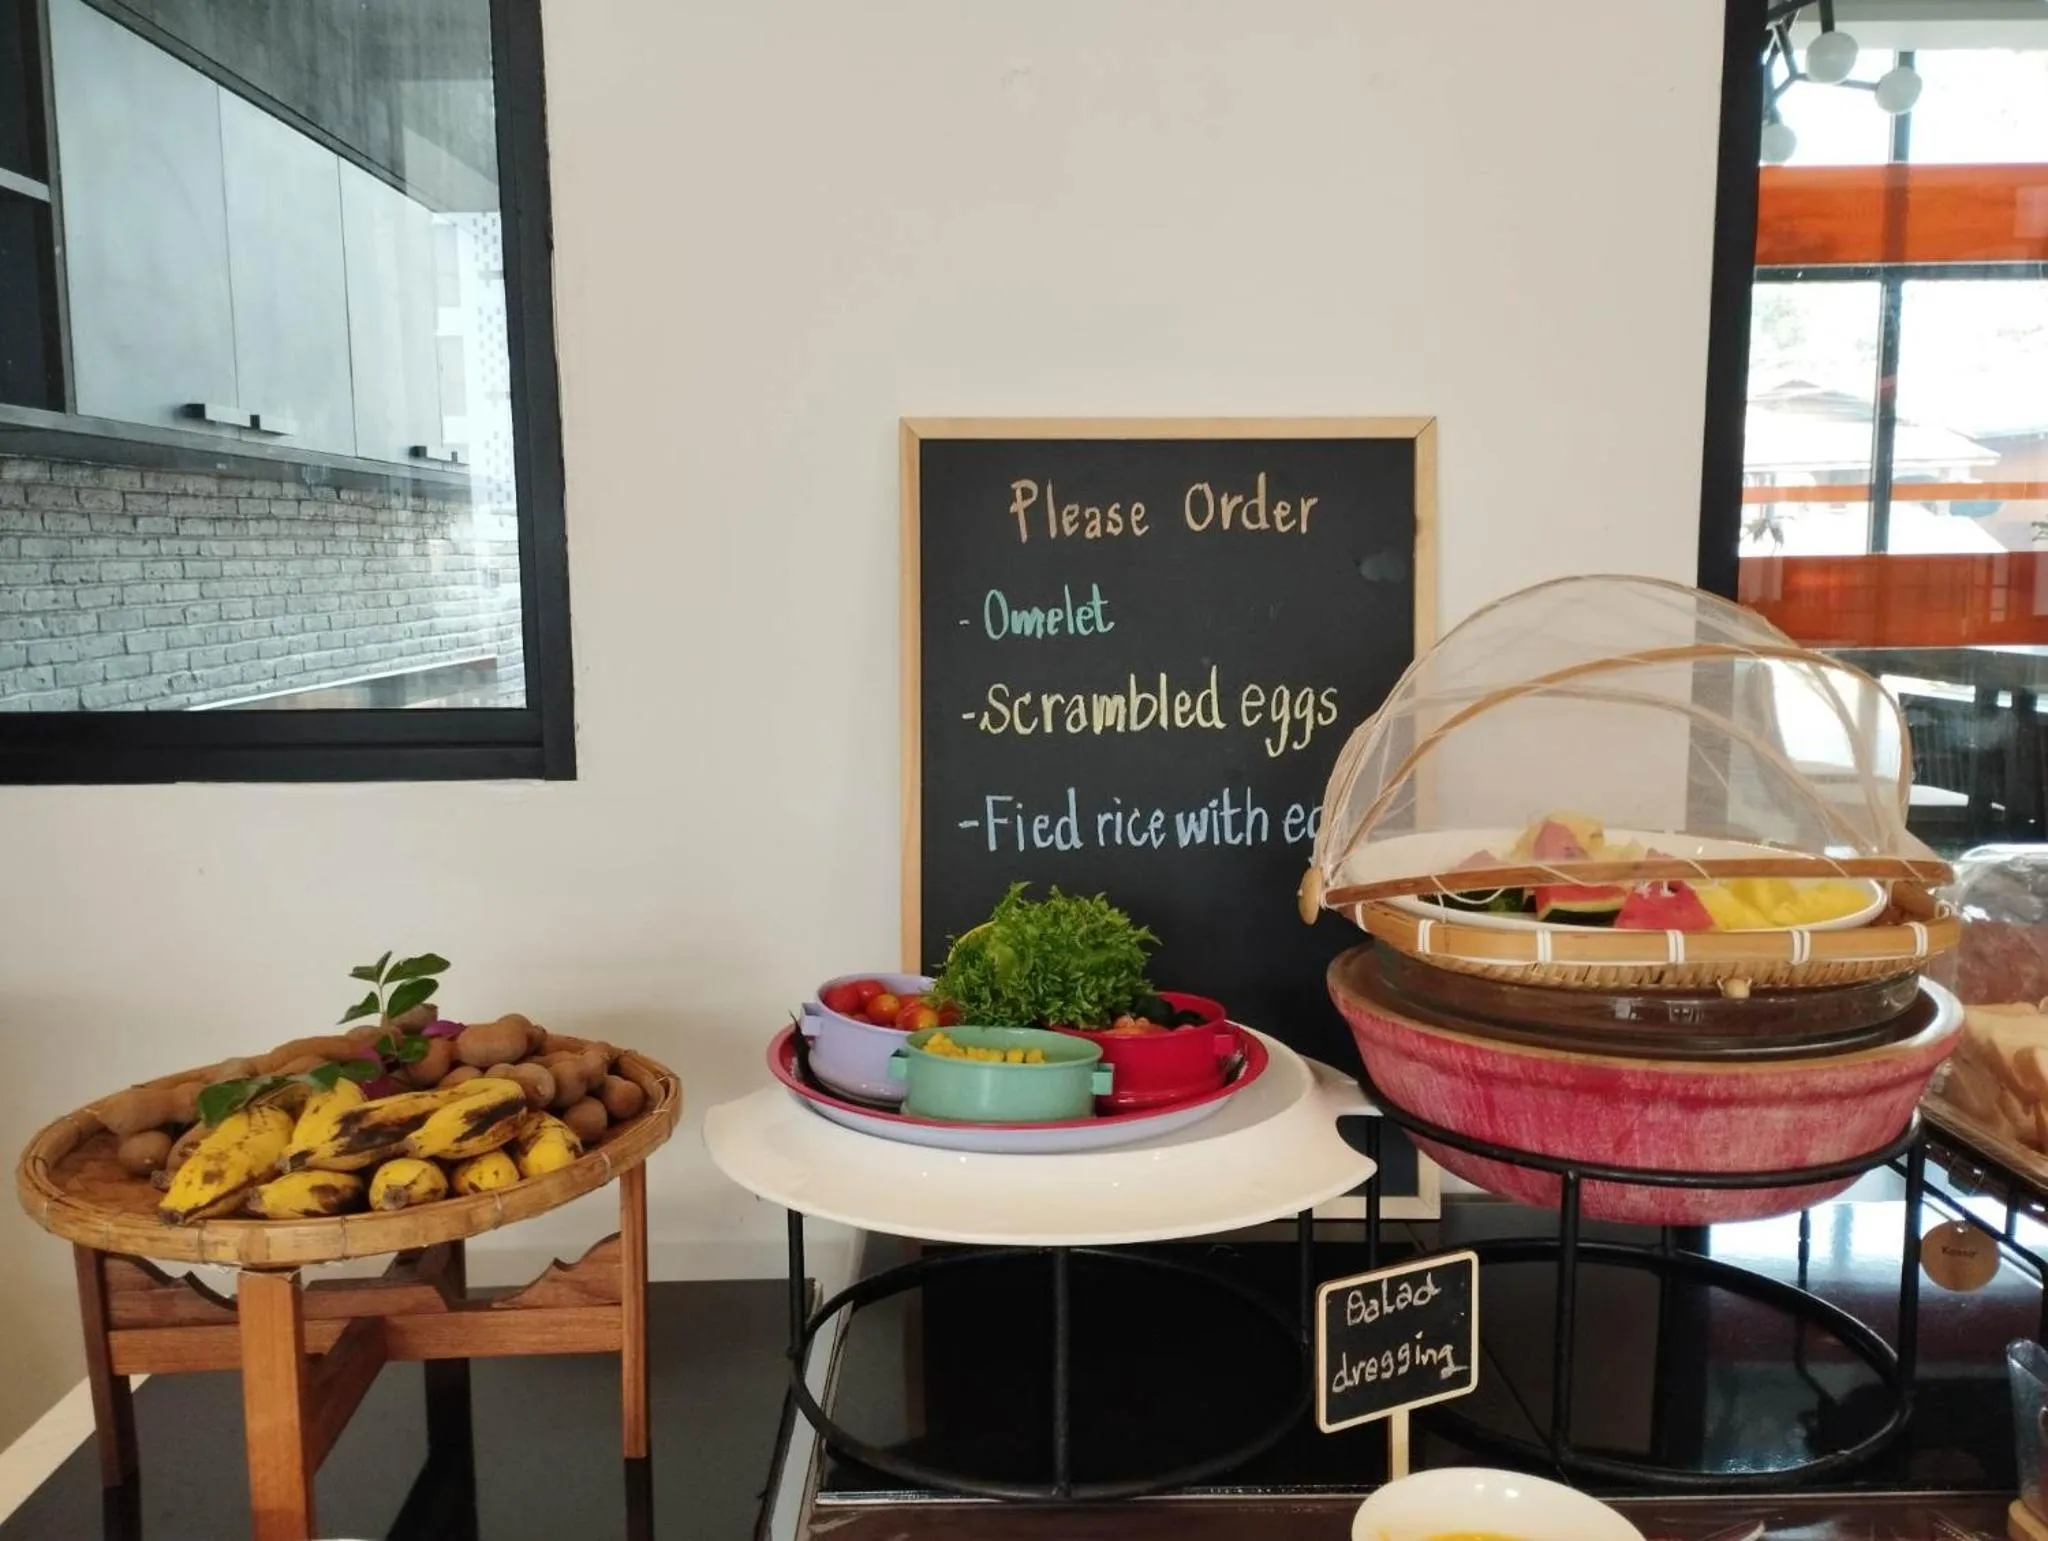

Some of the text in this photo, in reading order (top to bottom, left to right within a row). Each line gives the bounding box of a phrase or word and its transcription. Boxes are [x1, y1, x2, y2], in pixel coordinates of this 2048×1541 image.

[1009, 471, 1319, 544] Please Order
[983, 582, 1115, 641] Omelet
[1240, 683, 1339, 758] eggs
[1096, 796, 1166, 850] rice
[1176, 786, 1269, 850] with
